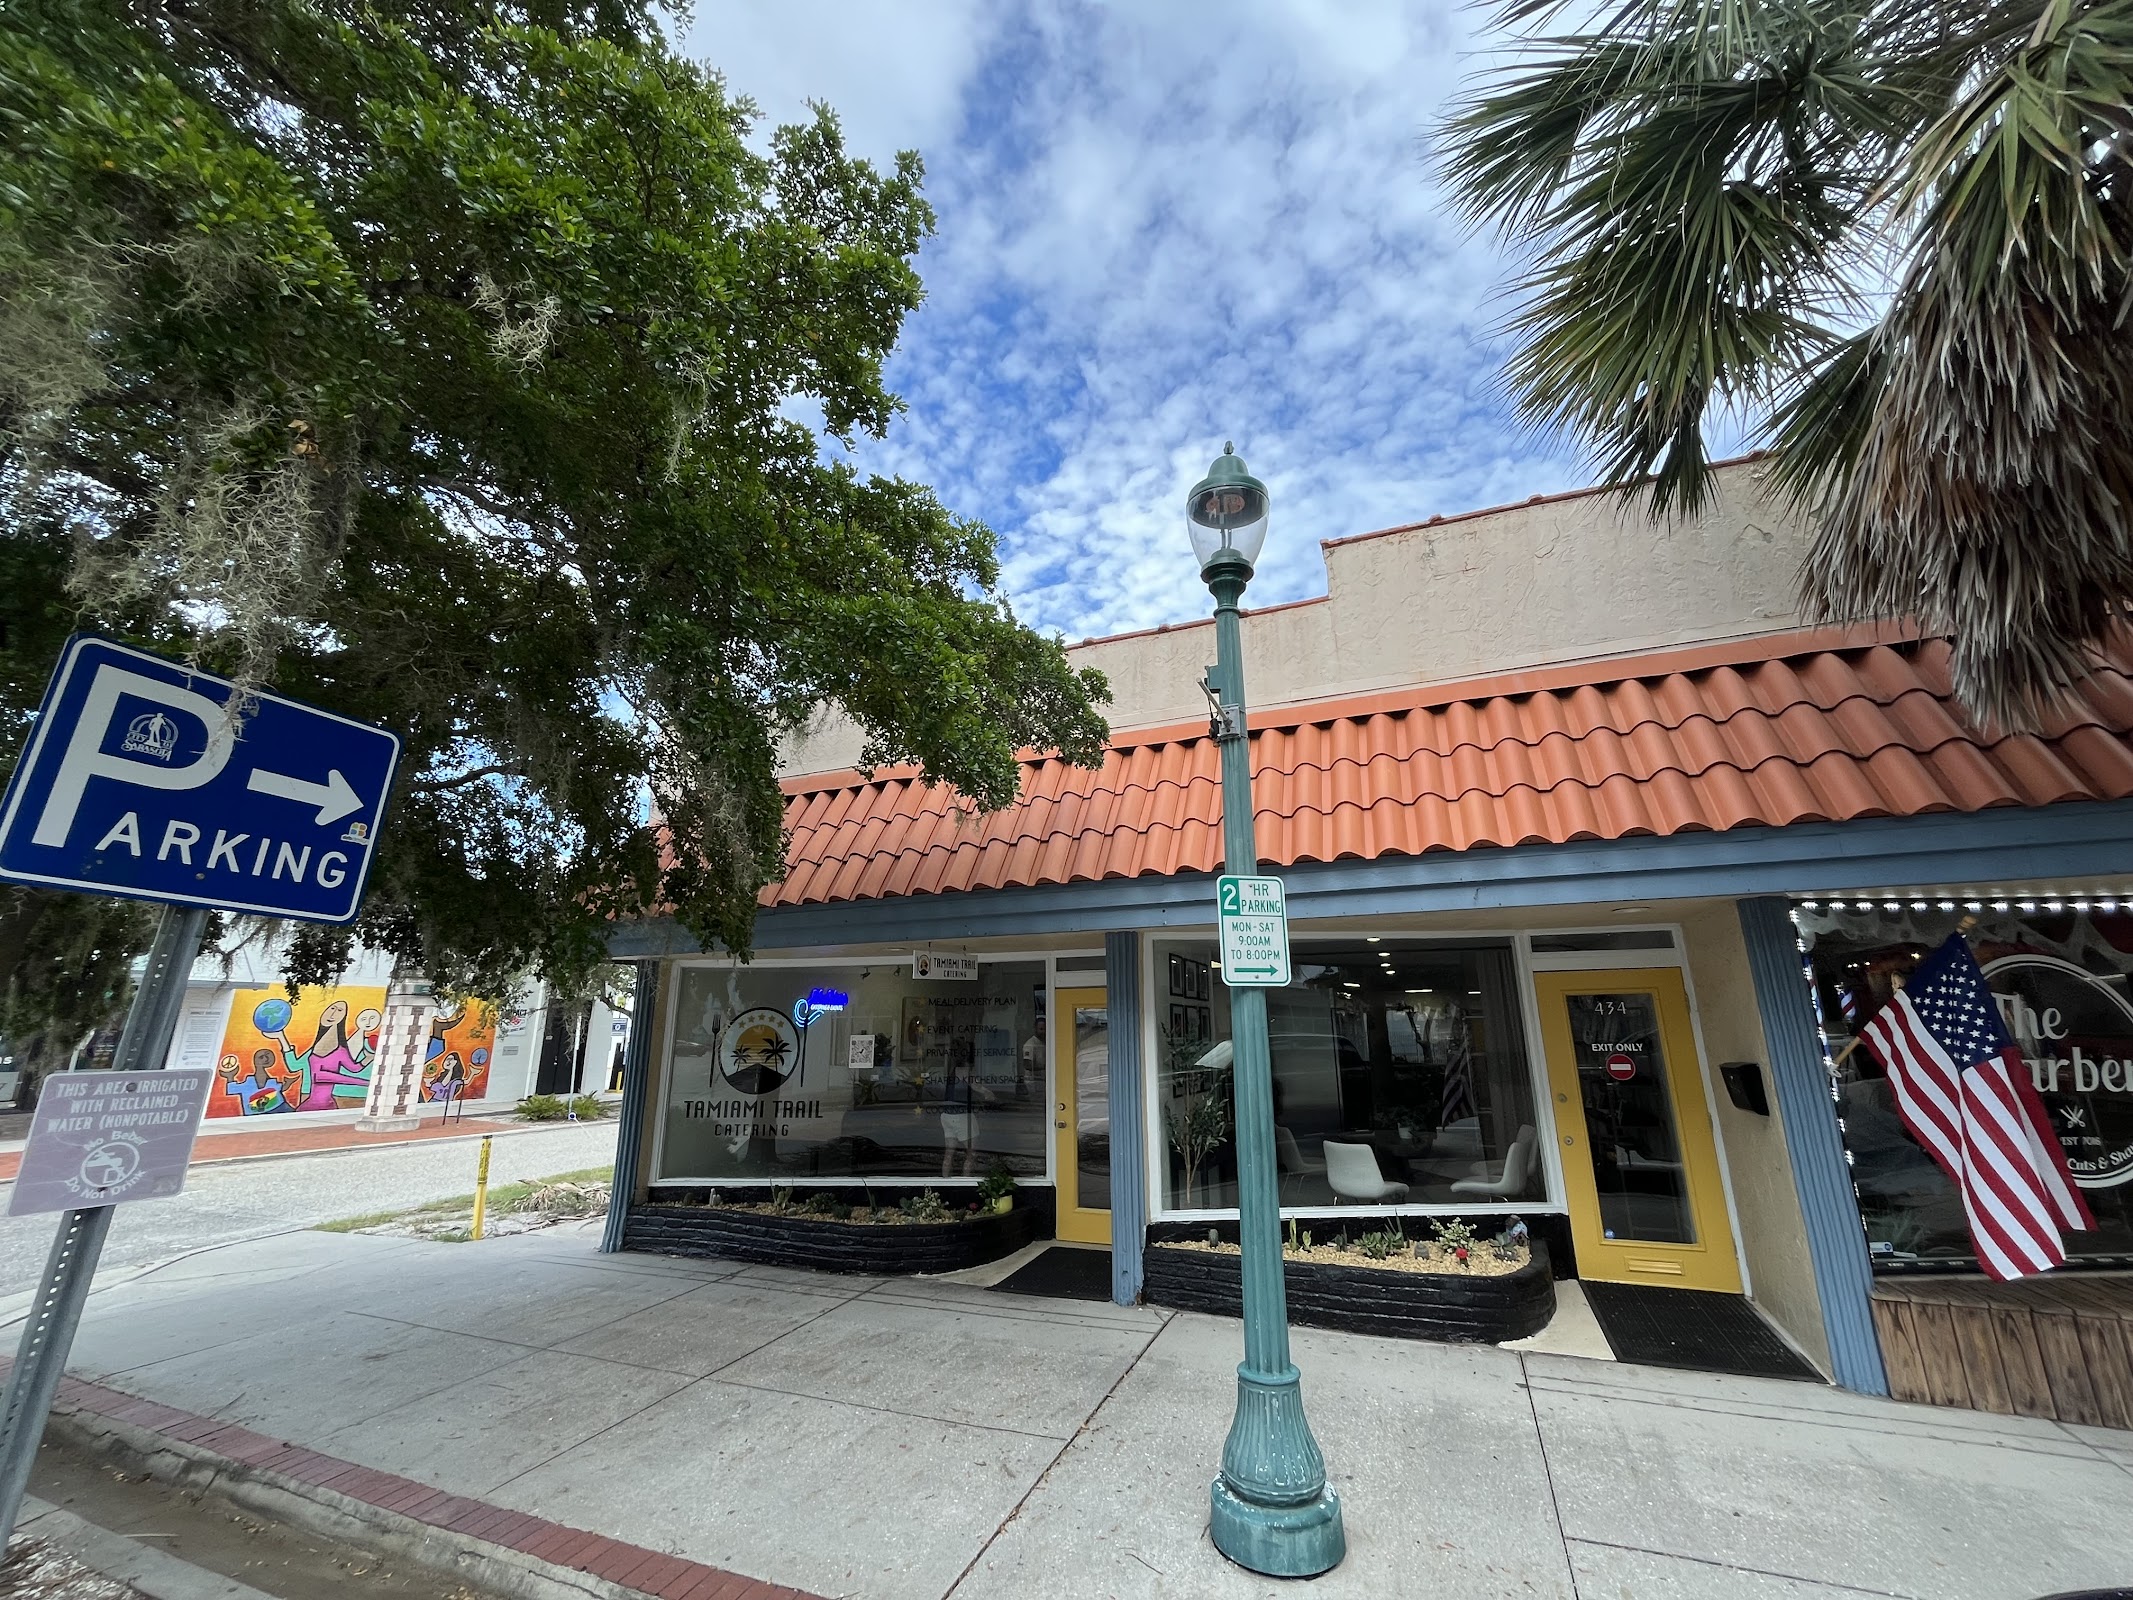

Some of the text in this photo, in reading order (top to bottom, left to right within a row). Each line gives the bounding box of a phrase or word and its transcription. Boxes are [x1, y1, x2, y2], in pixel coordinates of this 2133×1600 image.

[1222, 884, 1269, 910] 2 HR
[1241, 900, 1281, 913] PARKING
[1238, 936, 1271, 946] 9:00AM
[1231, 949, 1280, 960] TO 8:00PM
[934, 957, 976, 970] TAMIAMI TRAIL
[943, 970, 967, 978] CATERING
[928, 997, 1016, 1006] MEAL DELIVERY PLAN
[1594, 1001, 1627, 1015] 434
[1991, 992, 2069, 1040] The
[927, 1025, 998, 1034] EVENT CATERING
[926, 1048, 960, 1057] PRIVATE
[984, 1048, 1016, 1057] SERVICE
[1592, 1043, 1643, 1052] EXIT ONLY
[963, 1076, 999, 1084] KITCHEN
[1000, 1075, 1024, 1084] SPACE
[56, 1083, 87, 1098] THIS
[136, 1078, 199, 1093] IRRIGATED
[70, 1095, 179, 1114] WITH RECLAIMED
[684, 1100, 823, 1119] TAMIAMI TRAIL
[47, 1109, 189, 1133] WATER (NONPOTABLE)
[714, 1124, 789, 1136] CATERING
[83, 1130, 149, 1151] No Beber
[2067, 1158, 2097, 1170] Cuts
[2098, 1157, 2109, 1169] &
[64, 1176, 81, 1193] Do
[111, 1169, 147, 1196] Drink
